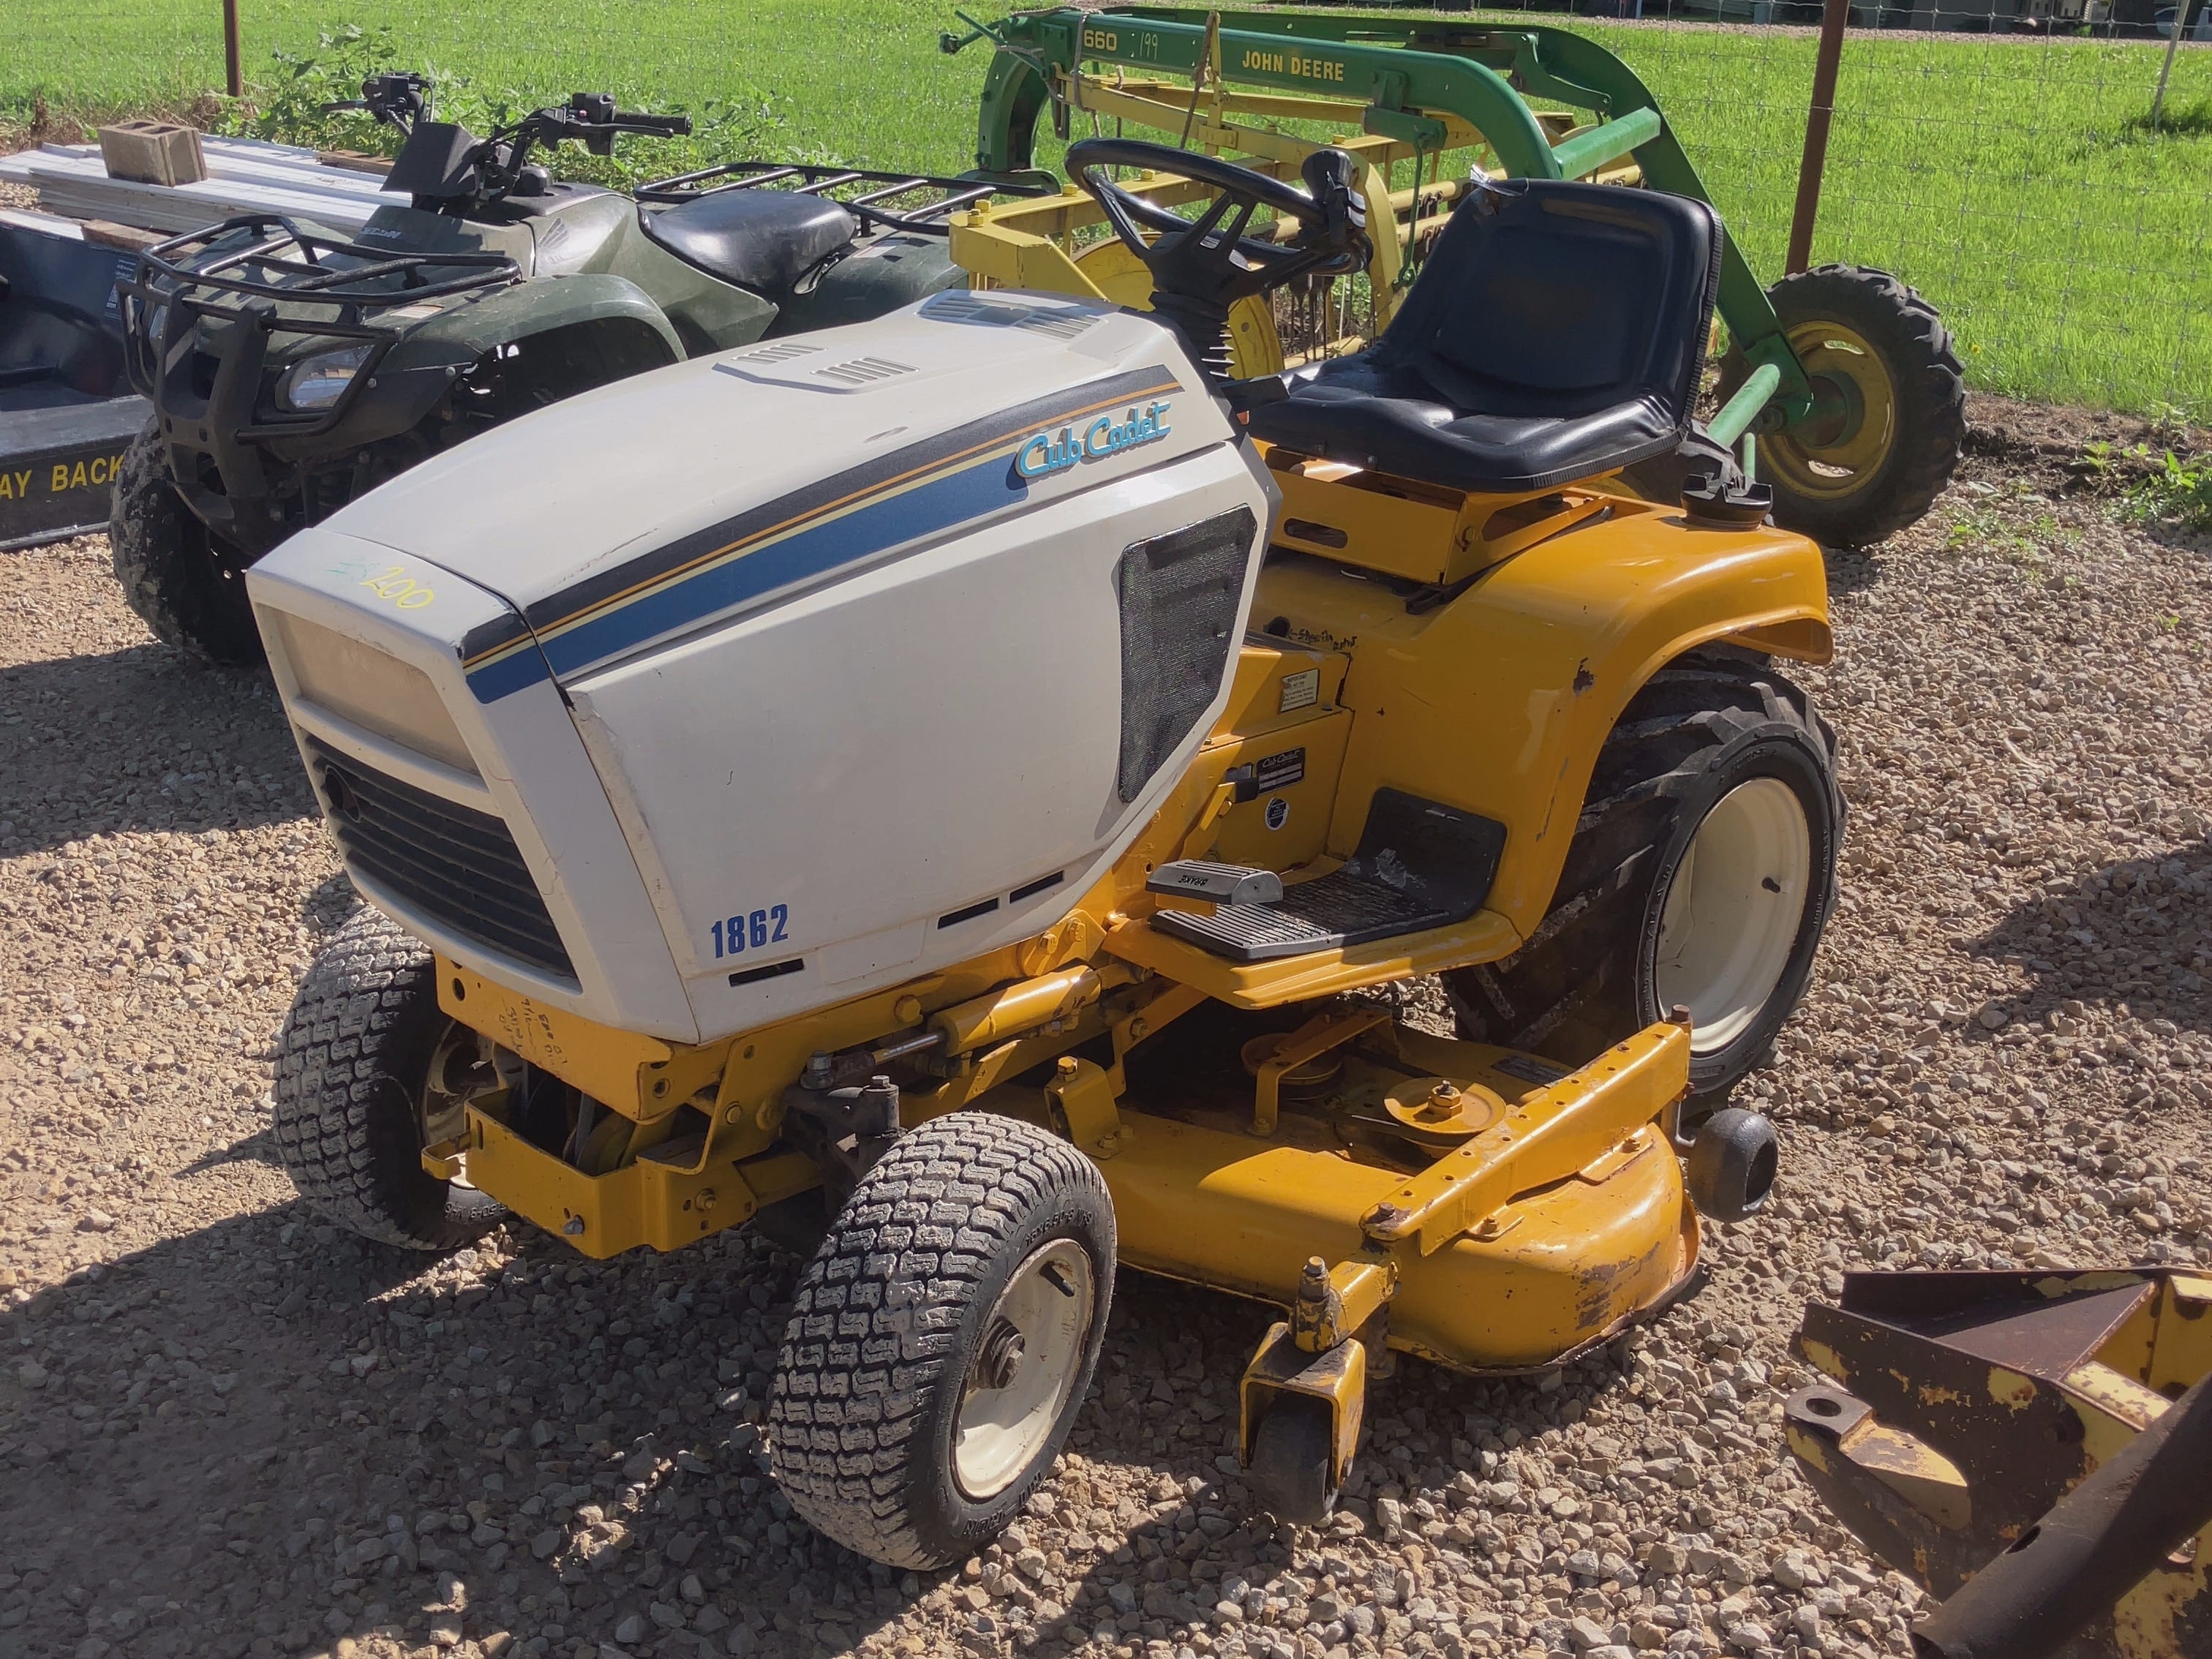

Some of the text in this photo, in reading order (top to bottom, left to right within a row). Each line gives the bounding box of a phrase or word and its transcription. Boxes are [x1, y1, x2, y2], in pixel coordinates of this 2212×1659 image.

[1083, 29, 1117, 52] 660
[1140, 31, 1158, 60] 199
[1242, 50, 1344, 82] JOHN DEERE
[1017, 402, 1170, 478] Cub Cadet
[51, 454, 126, 492] BACK
[711, 903, 789, 958] 1862
